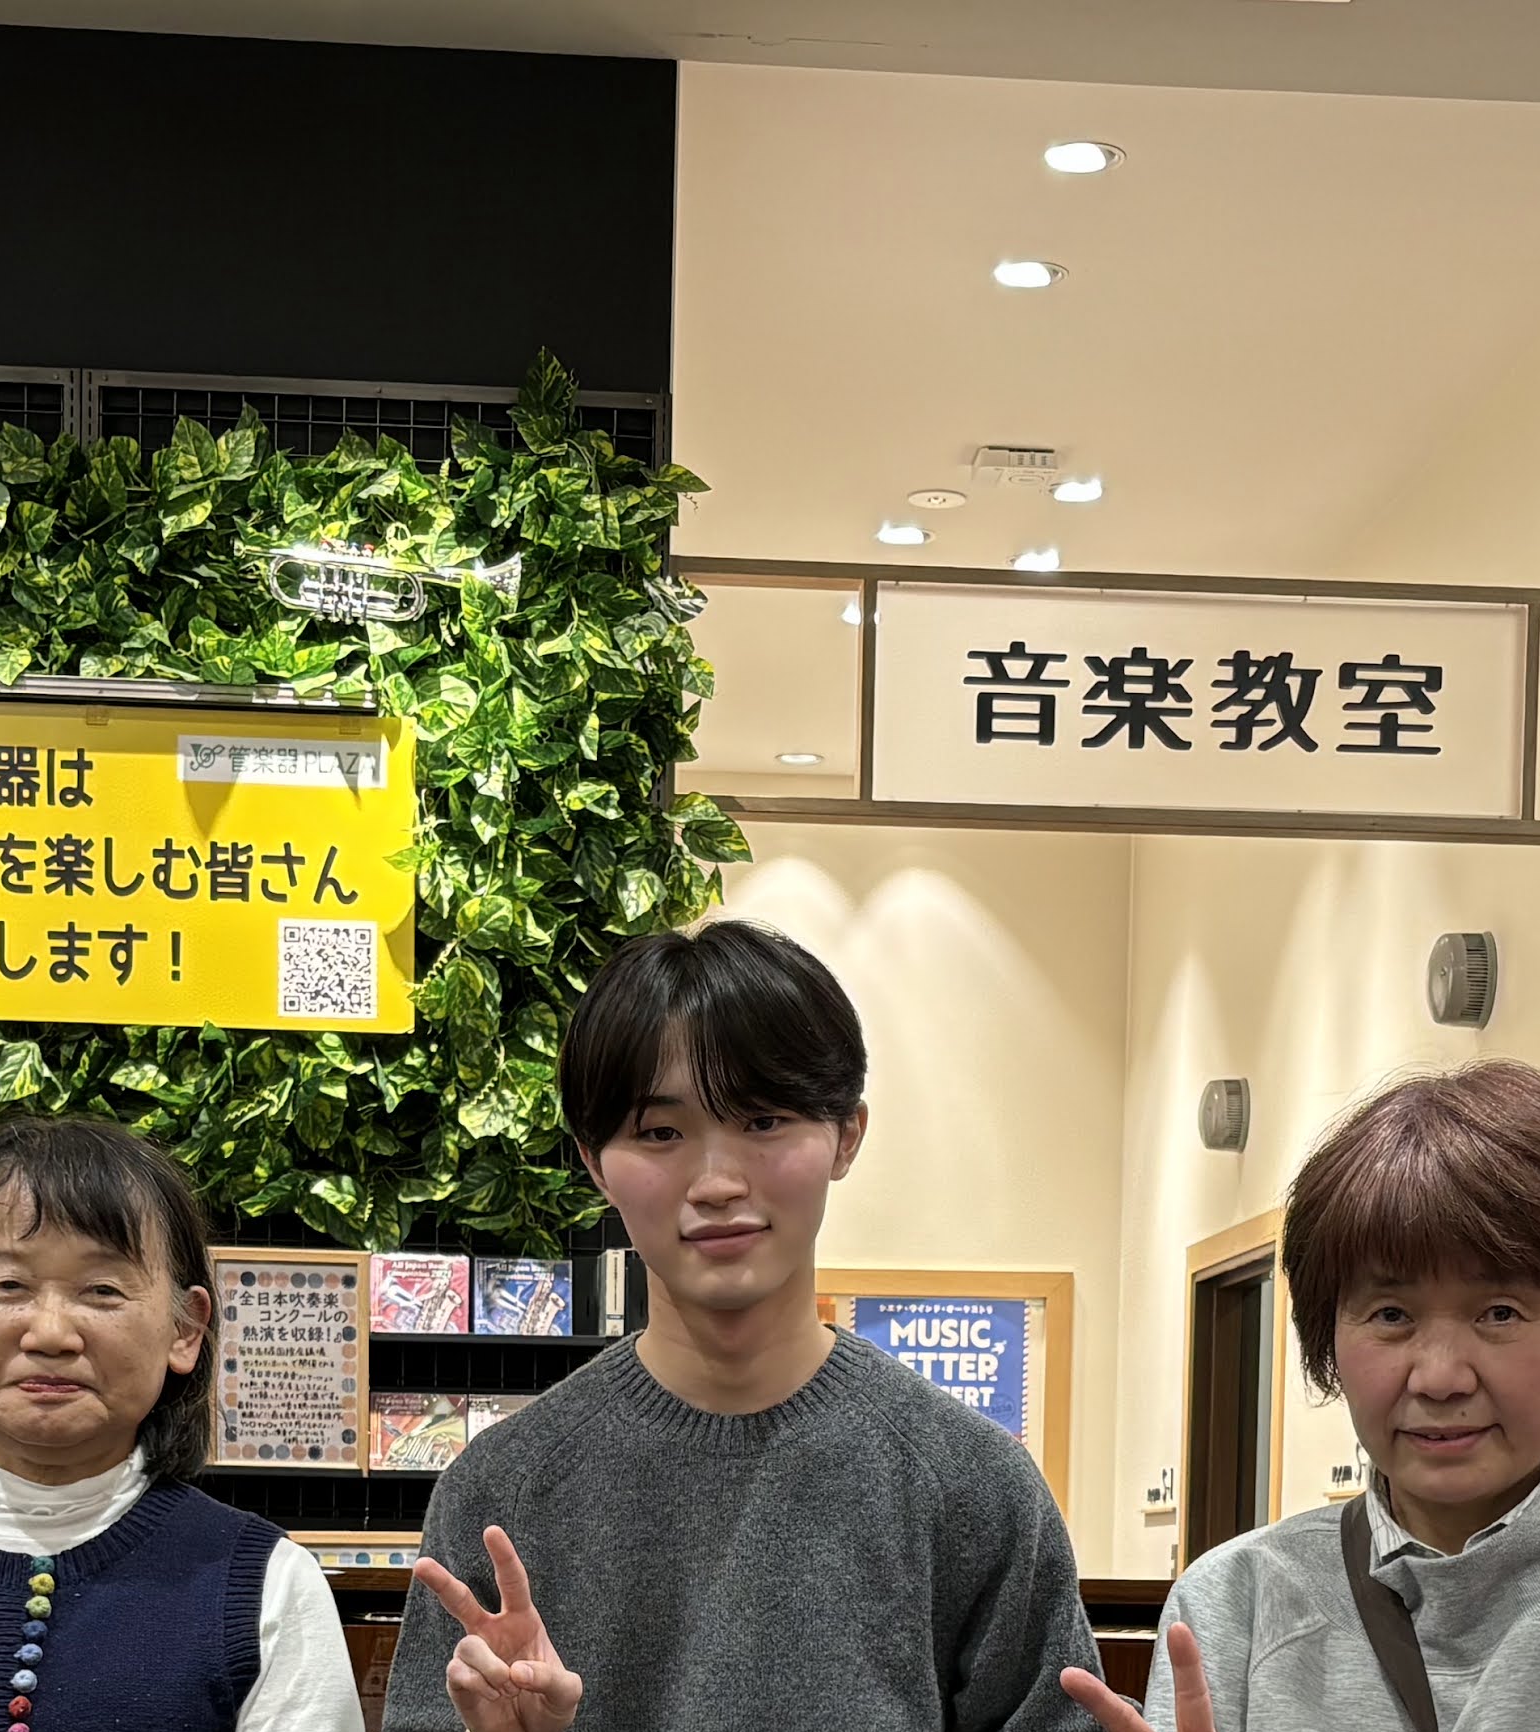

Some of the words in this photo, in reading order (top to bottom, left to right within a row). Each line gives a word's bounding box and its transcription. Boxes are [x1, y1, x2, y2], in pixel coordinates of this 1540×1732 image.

[963, 641, 1443, 756] 音楽教室
[259, 1309, 349, 1324] コンクールの
[890, 1318, 991, 1348] MUSIC
[897, 1351, 999, 1382] ETTER
